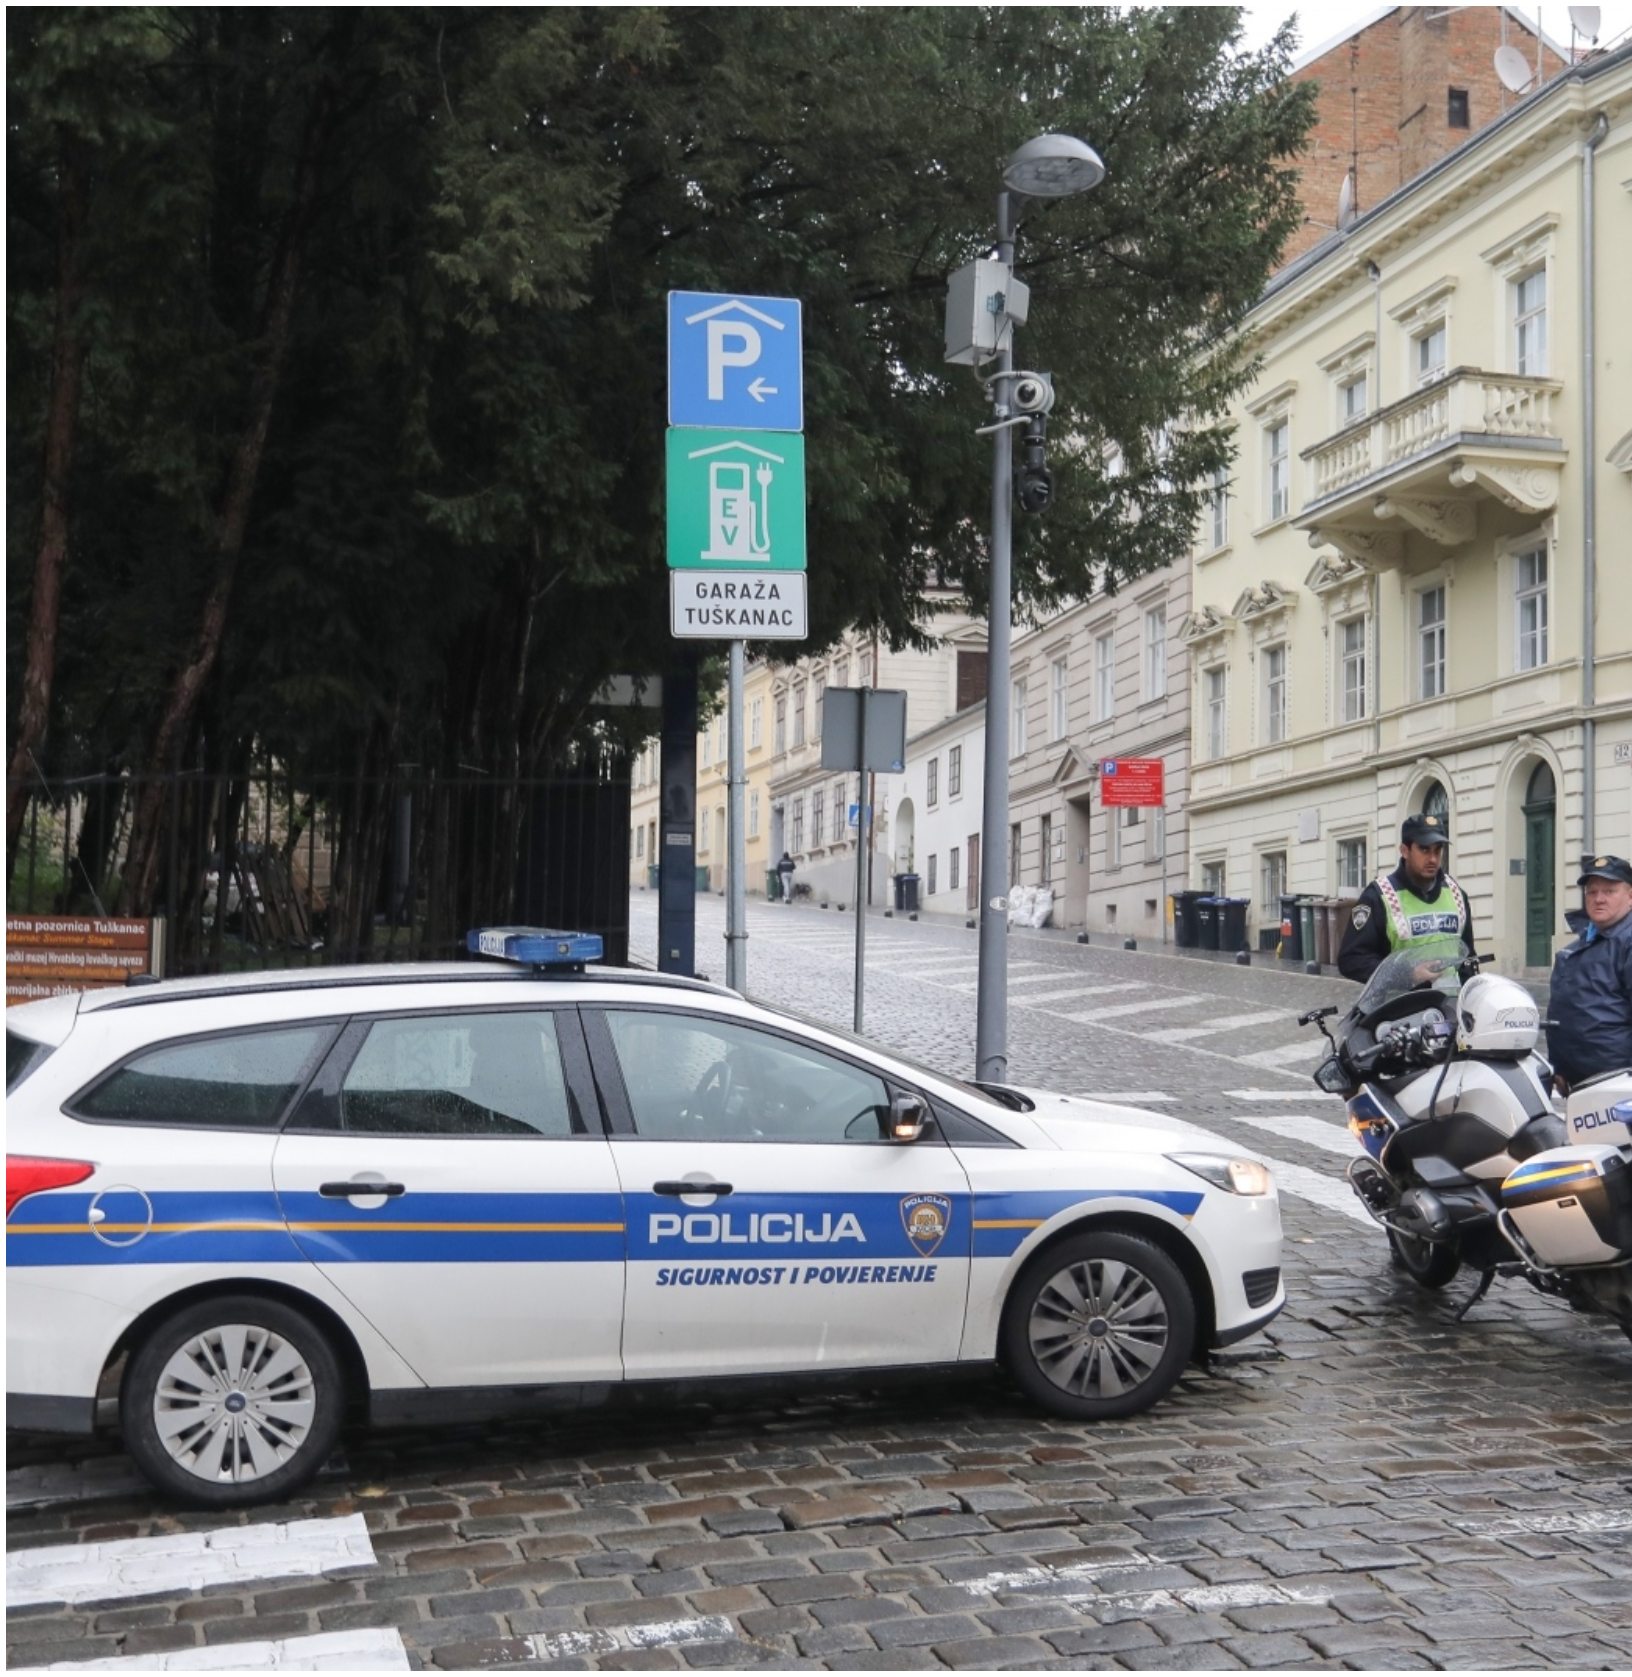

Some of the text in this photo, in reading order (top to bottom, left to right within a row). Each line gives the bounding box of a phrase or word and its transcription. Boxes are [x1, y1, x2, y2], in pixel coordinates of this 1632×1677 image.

[706, 319, 762, 401] P
[695, 578, 781, 601] GARAŽA
[684, 604, 793, 626] TUŠKANAC
[1104, 762, 1114, 774] P
[35, 920, 90, 933] pozornica
[93, 920, 146, 934] Tuškanac
[1412, 917, 1458, 933] POLICIJA
[1573, 1106, 1617, 1133] POLIC
[648, 1213, 867, 1244] POLICIJA
[655, 1264, 938, 1287] SIGURNOST I POVJERENJE
